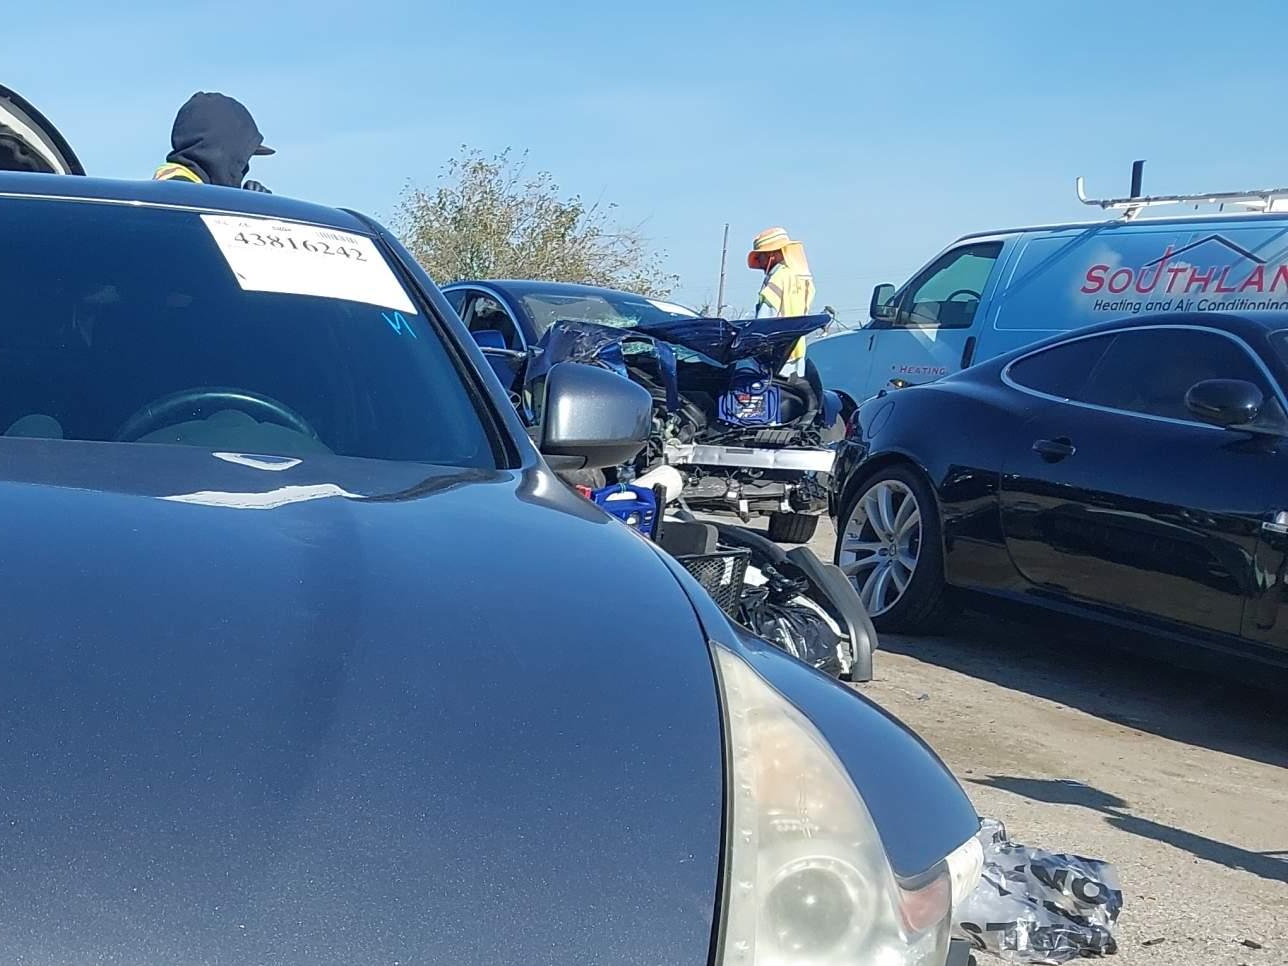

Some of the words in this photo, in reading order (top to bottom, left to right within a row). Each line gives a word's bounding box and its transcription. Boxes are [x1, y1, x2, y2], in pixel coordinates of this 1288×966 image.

[234, 231, 368, 262] 43816242
[1093, 299, 1142, 314] Heating
[1145, 299, 1171, 312] and
[1175, 298, 1193, 312] Air
[899, 365, 946, 376] HEATING
